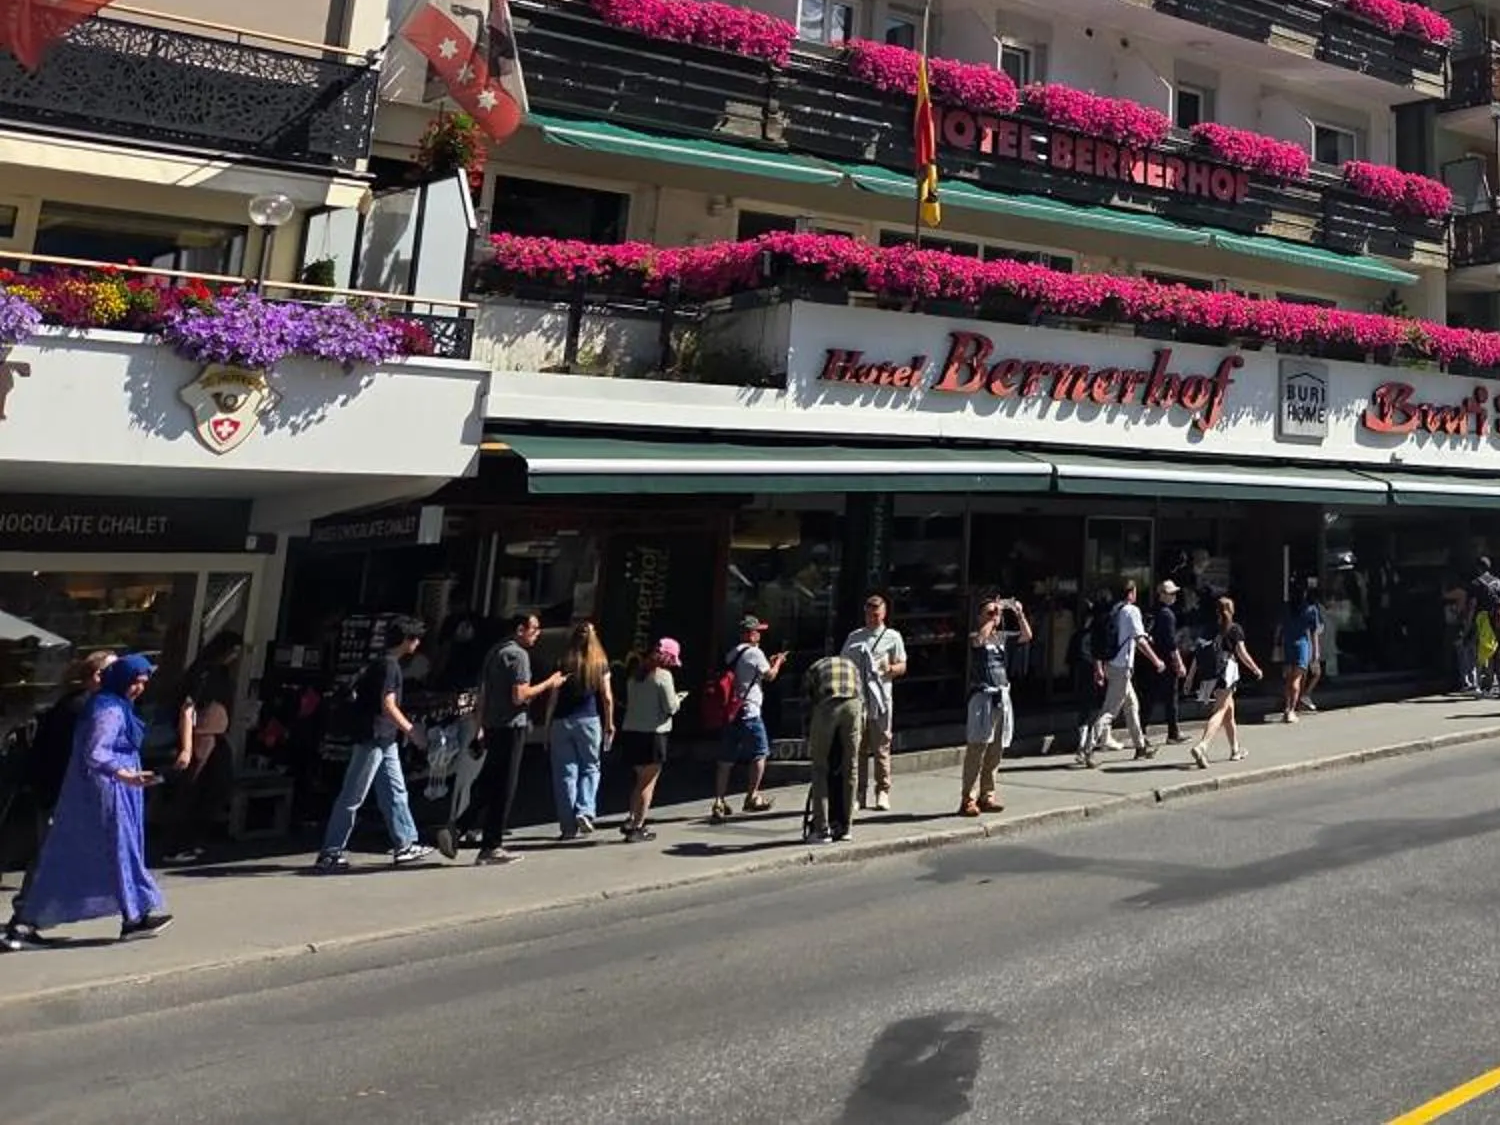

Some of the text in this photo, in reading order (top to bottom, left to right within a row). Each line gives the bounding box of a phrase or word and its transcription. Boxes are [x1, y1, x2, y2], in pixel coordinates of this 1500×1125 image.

[1050, 132, 1249, 204] BERNERHOF
[818, 330, 1244, 432] Hotel Bernerhof
[1286, 384, 1325, 404] BURI
[1287, 402, 1326, 424] HOME
[1362, 381, 1489, 436] Buri
[98, 514, 169, 535] CHALET
